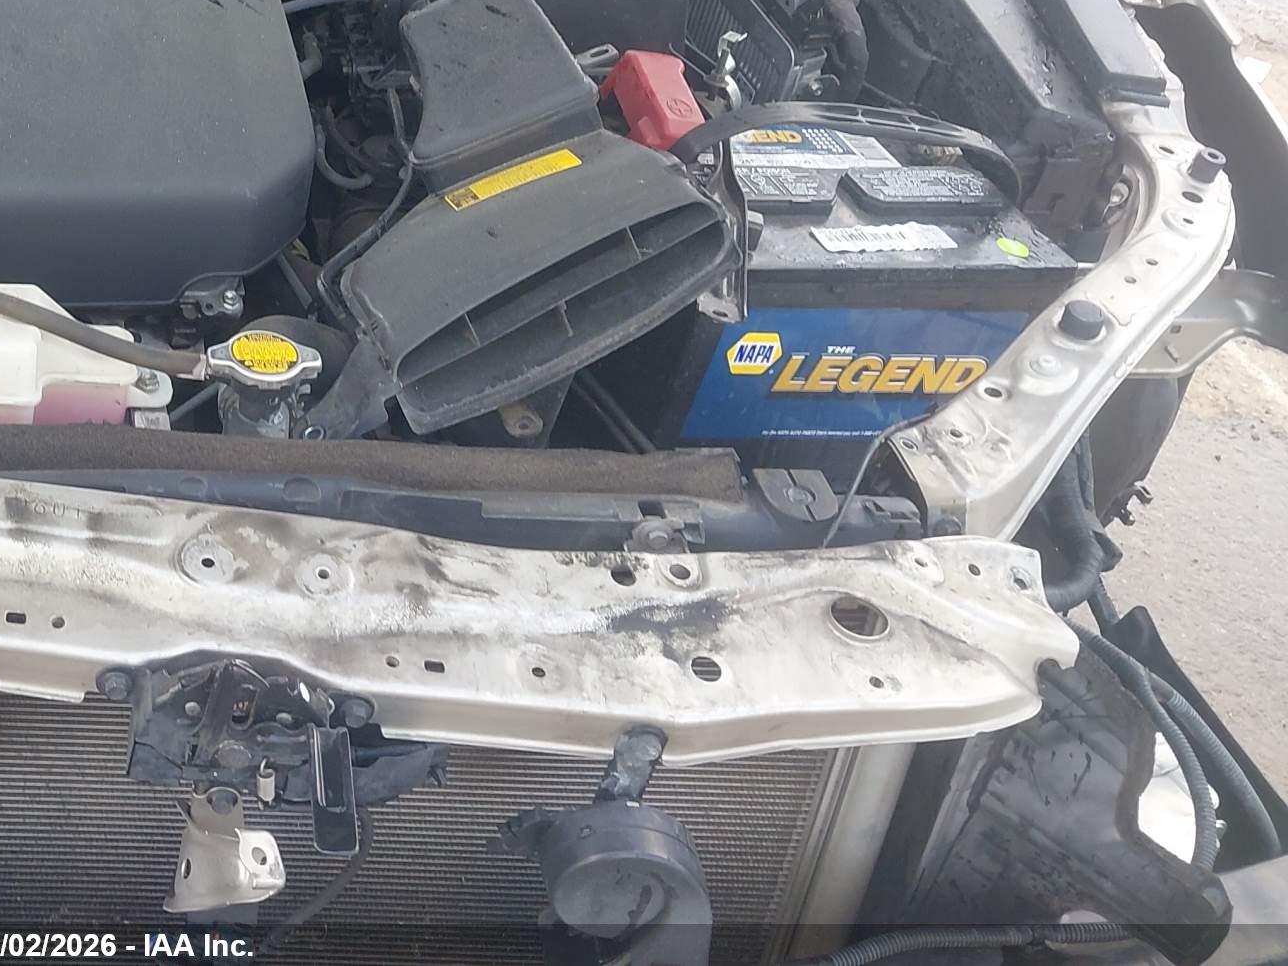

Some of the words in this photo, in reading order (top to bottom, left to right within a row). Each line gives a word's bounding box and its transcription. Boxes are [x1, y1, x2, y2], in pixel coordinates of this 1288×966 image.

[733, 344, 774, 363] NAPA
[826, 345, 856, 354] THE
[771, 353, 989, 393] LEGEND
